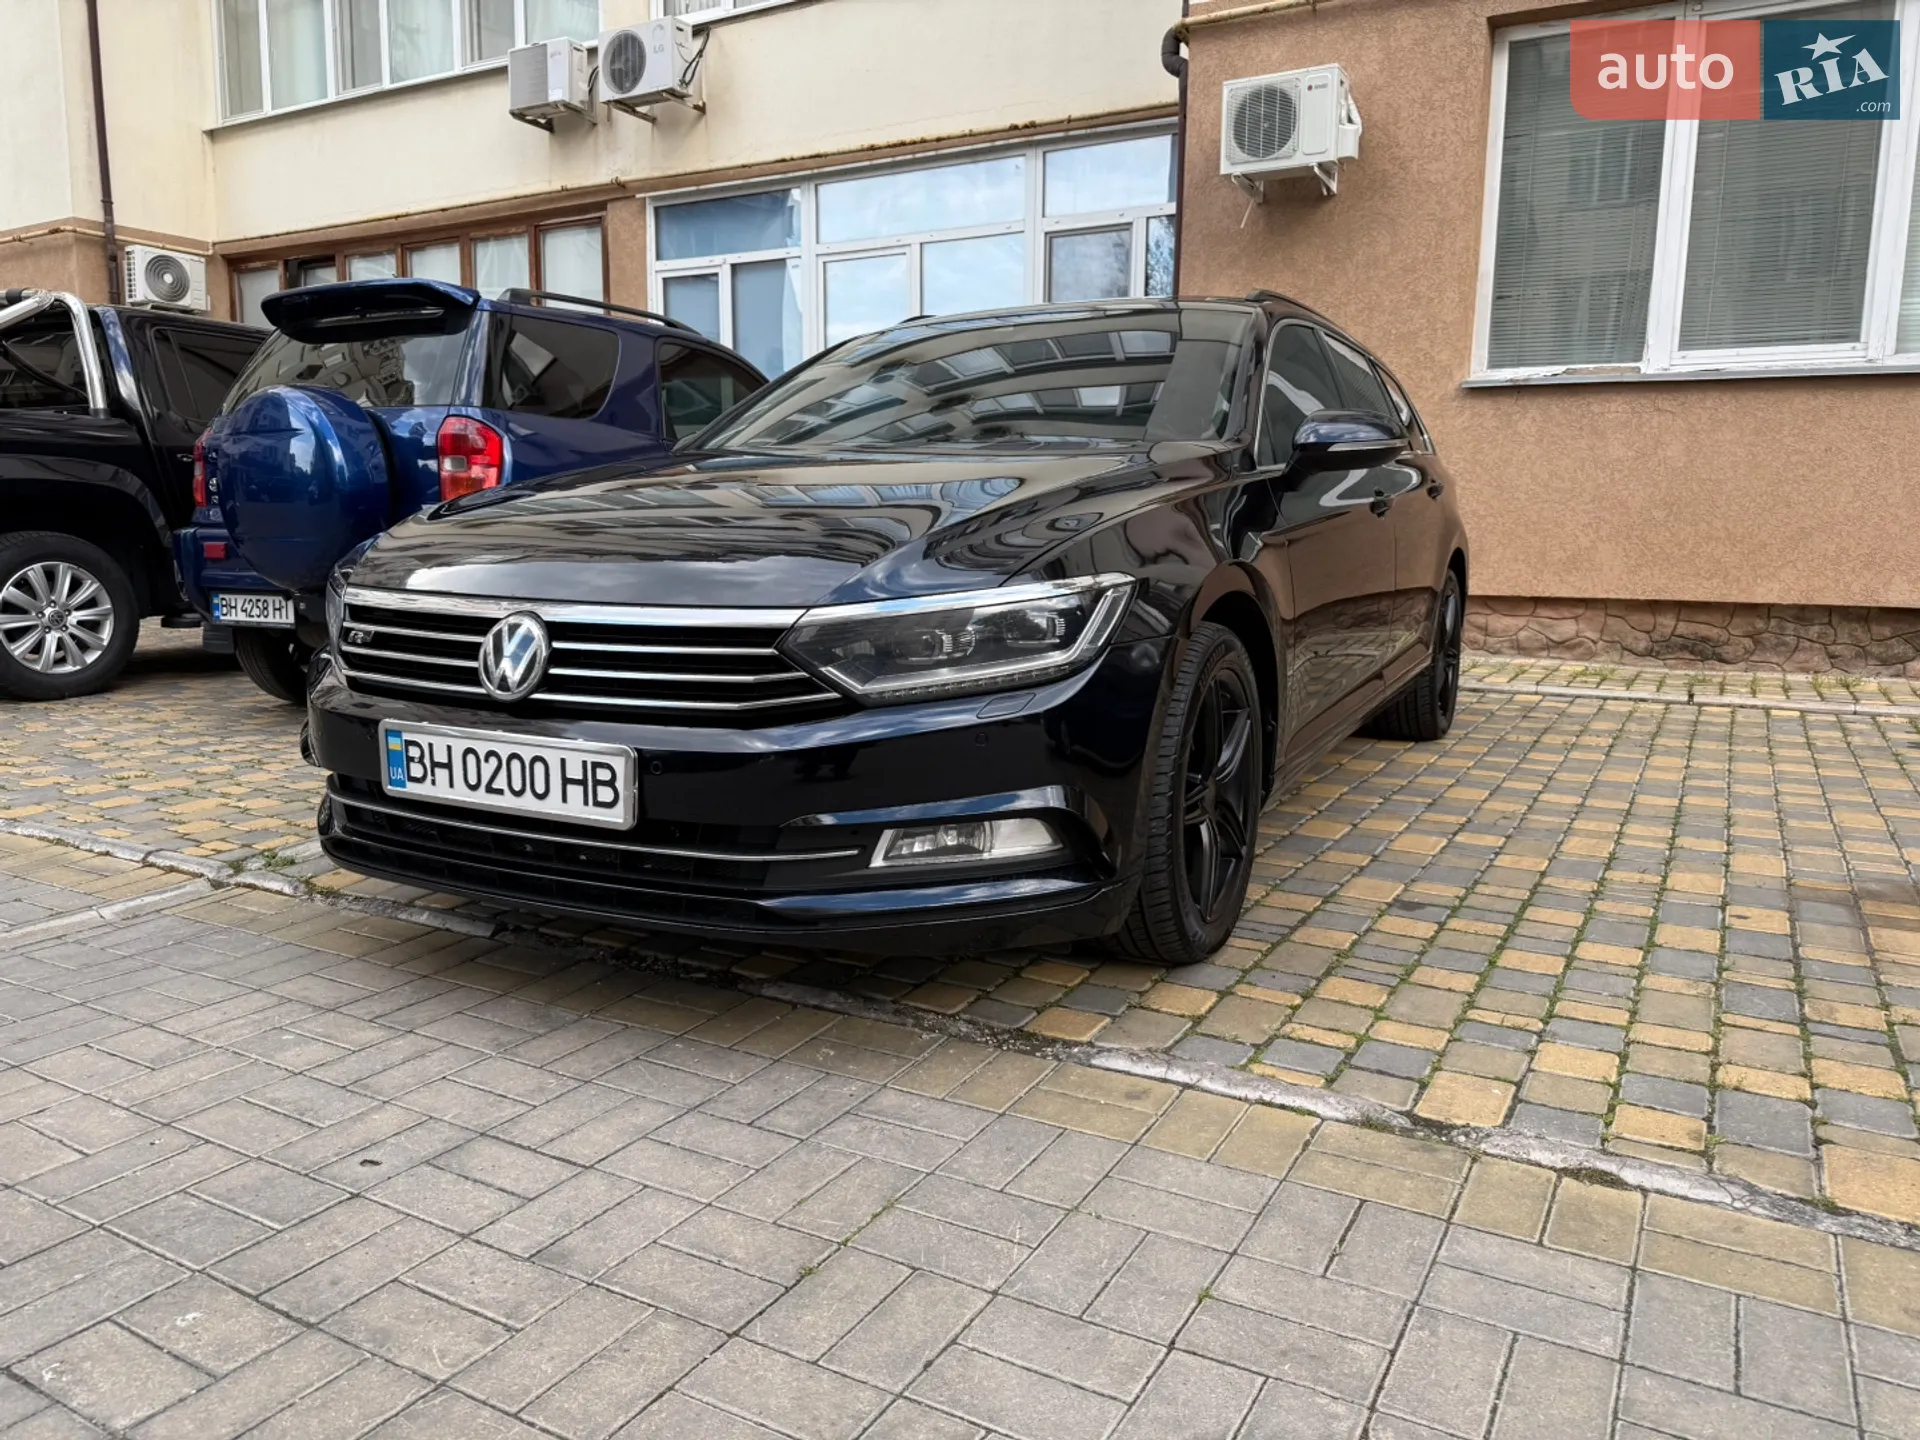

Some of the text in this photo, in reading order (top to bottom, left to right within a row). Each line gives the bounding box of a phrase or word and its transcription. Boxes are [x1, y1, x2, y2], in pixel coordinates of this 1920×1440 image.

[653, 43, 665, 54] LG
[220, 597, 238, 617] BH
[240, 598, 269, 618] 4258
[390, 766, 404, 780] UA
[404, 739, 620, 809] BH 0200 HB
